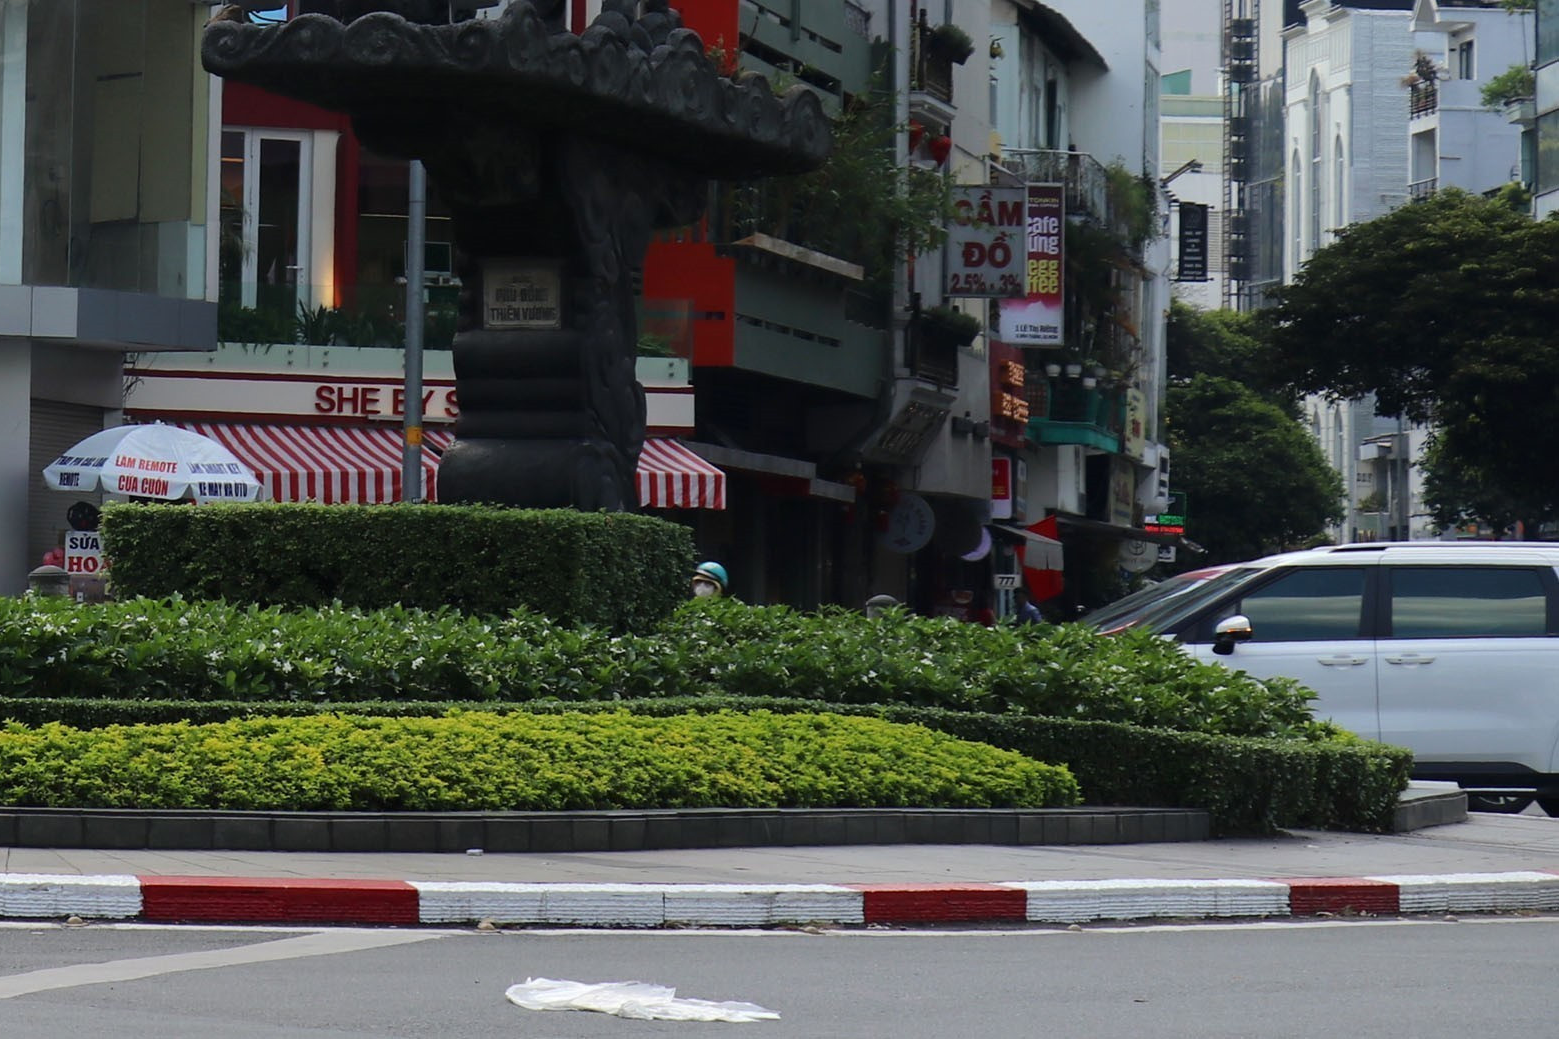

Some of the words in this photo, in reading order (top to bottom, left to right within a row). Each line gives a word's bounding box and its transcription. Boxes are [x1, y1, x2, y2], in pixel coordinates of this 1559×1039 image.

[953, 189, 1024, 227] CẦM
[962, 231, 1013, 269] ĐỒ
[999, 273, 1023, 294] 3%
[314, 385, 381, 415] SHE
[138, 459, 179, 475] REMOTE
[69, 532, 100, 551] SỬA
